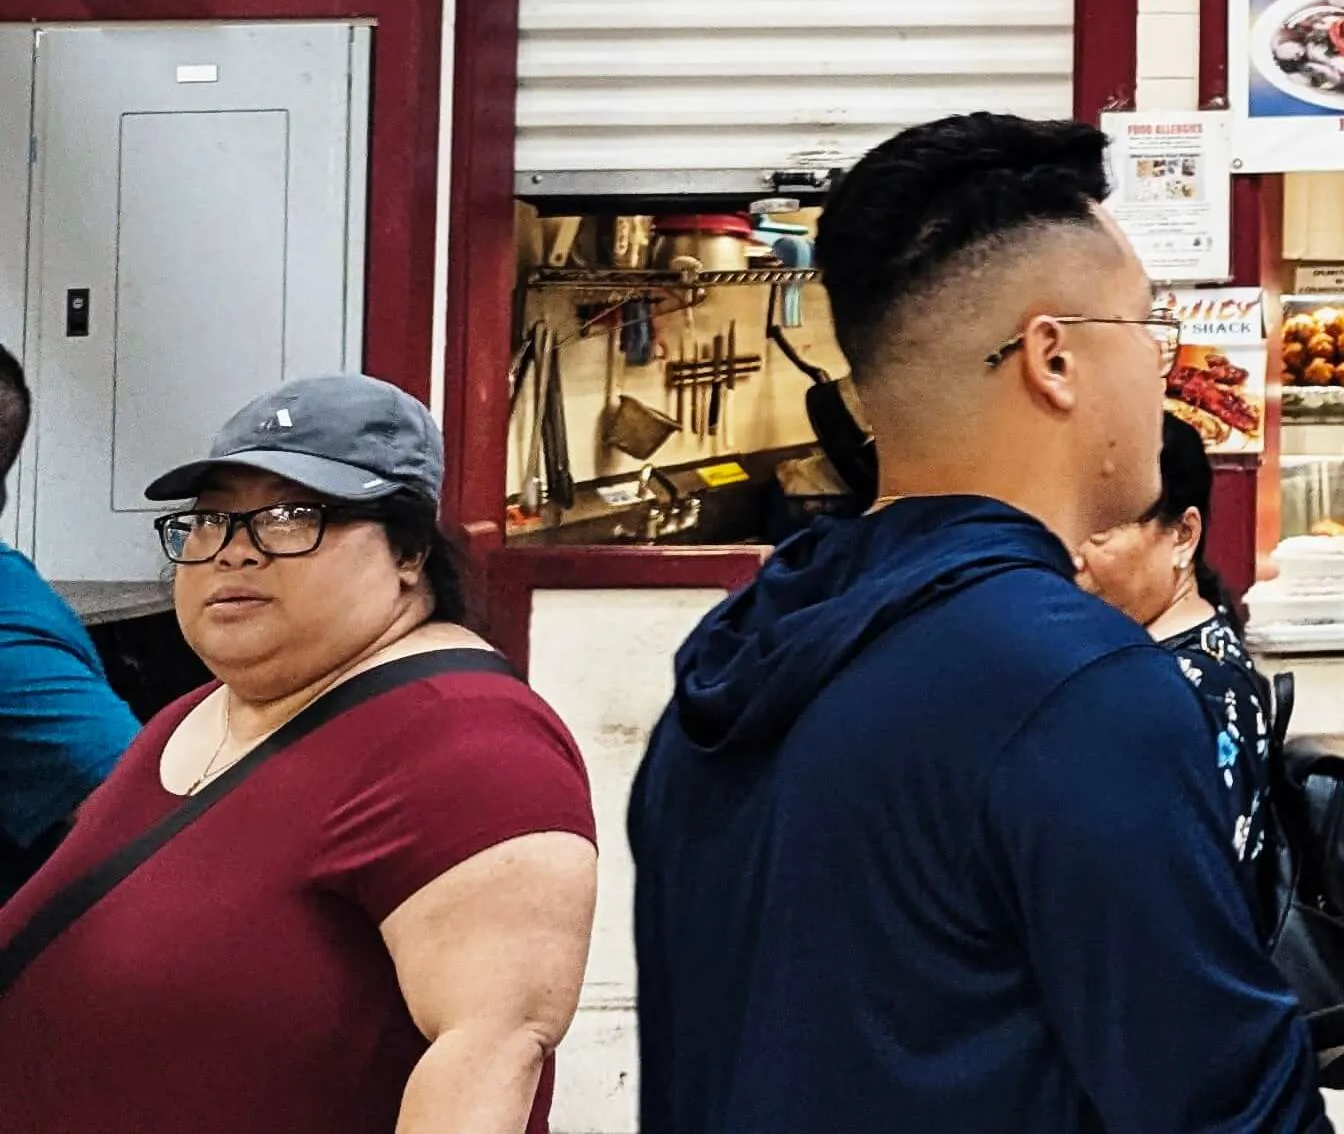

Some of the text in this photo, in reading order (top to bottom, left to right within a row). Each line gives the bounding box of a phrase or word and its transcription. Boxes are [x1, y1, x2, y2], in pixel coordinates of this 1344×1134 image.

[1128, 124, 1203, 135] FOOD ALLERGIES
[1192, 323, 1251, 334] SHACK
